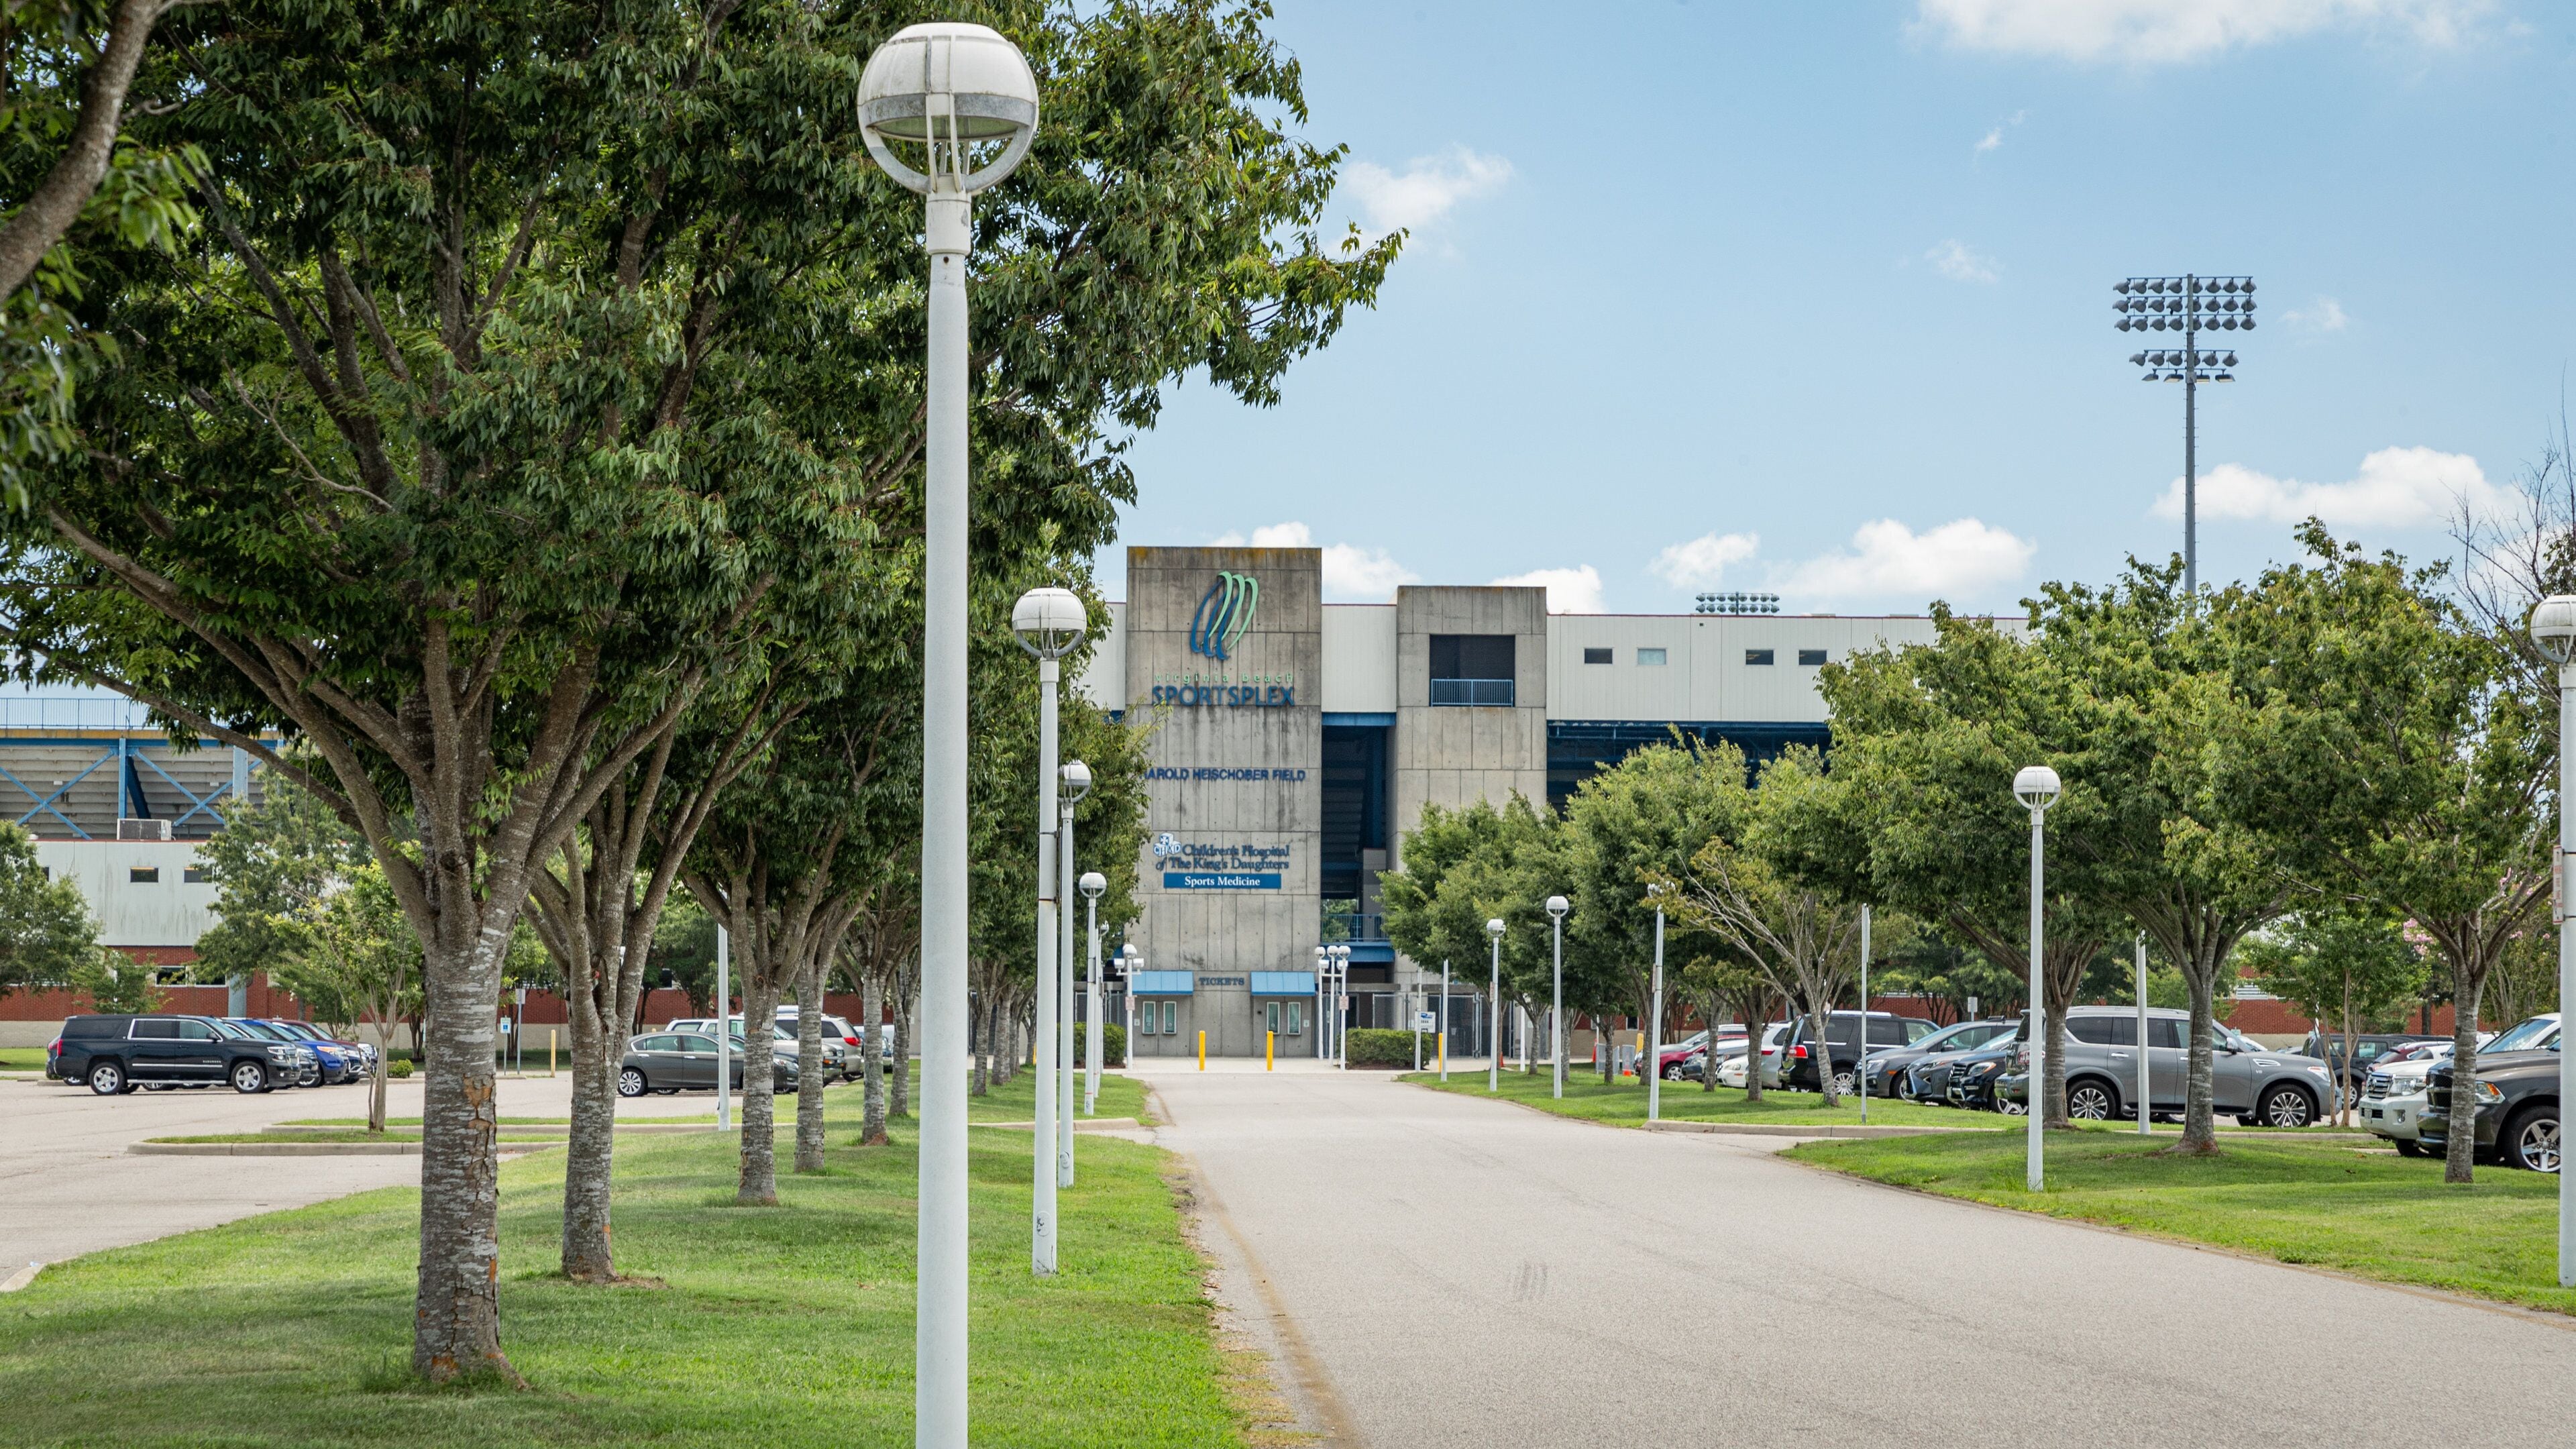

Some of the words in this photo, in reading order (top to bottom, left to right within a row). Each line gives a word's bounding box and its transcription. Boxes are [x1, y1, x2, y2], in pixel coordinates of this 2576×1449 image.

[1155, 673, 1228, 684] virginia
[1242, 673, 1293, 683] beach
[1152, 685, 1295, 706] SPORTSPLEX
[1193, 768, 1269, 781] HEISCHOBER
[1272, 769, 1305, 782] FIELD
[1154, 844, 1181, 856] CHKD
[1182, 844, 1238, 856] Children's
[1242, 845, 1289, 859] Hospital
[1156, 857, 1167, 871] of
[1169, 857, 1191, 869] The
[1193, 857, 1228, 871] King's
[1231, 857, 1289, 871] Daughters
[1185, 875, 1215, 888] Sports
[1218, 875, 1260, 886] Medicine
[1199, 977, 1245, 986] TICKETS
